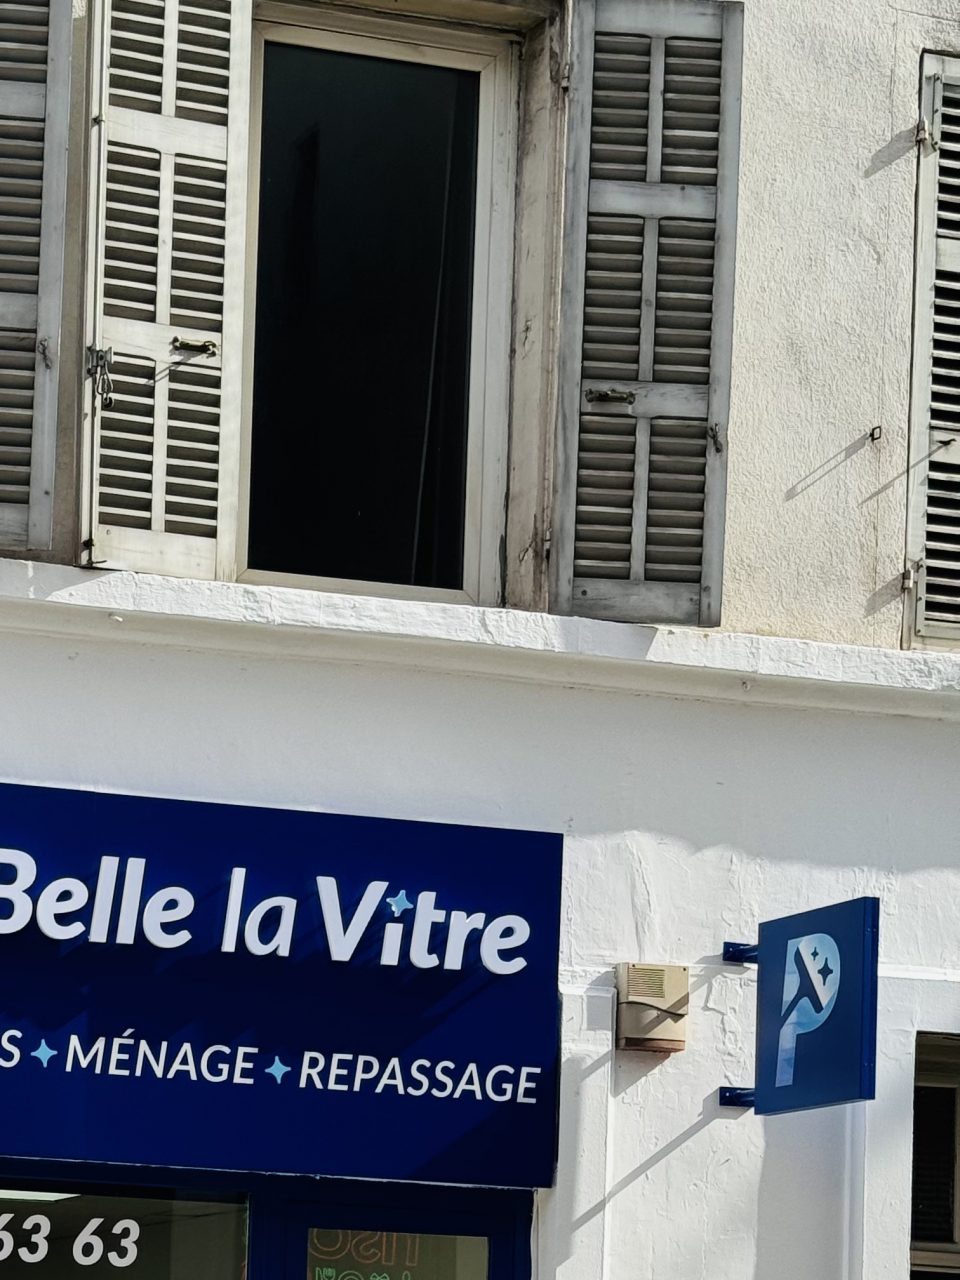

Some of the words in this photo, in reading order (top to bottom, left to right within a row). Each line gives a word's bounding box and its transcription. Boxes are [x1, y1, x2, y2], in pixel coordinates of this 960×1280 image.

[221, 867, 297, 957] la
[316, 876, 531, 975] Vitre
[64, 1028, 260, 1085] MÉNAGE
[298, 1051, 542, 1104] REPASSAGE
[71, 1217, 140, 1268] 63
